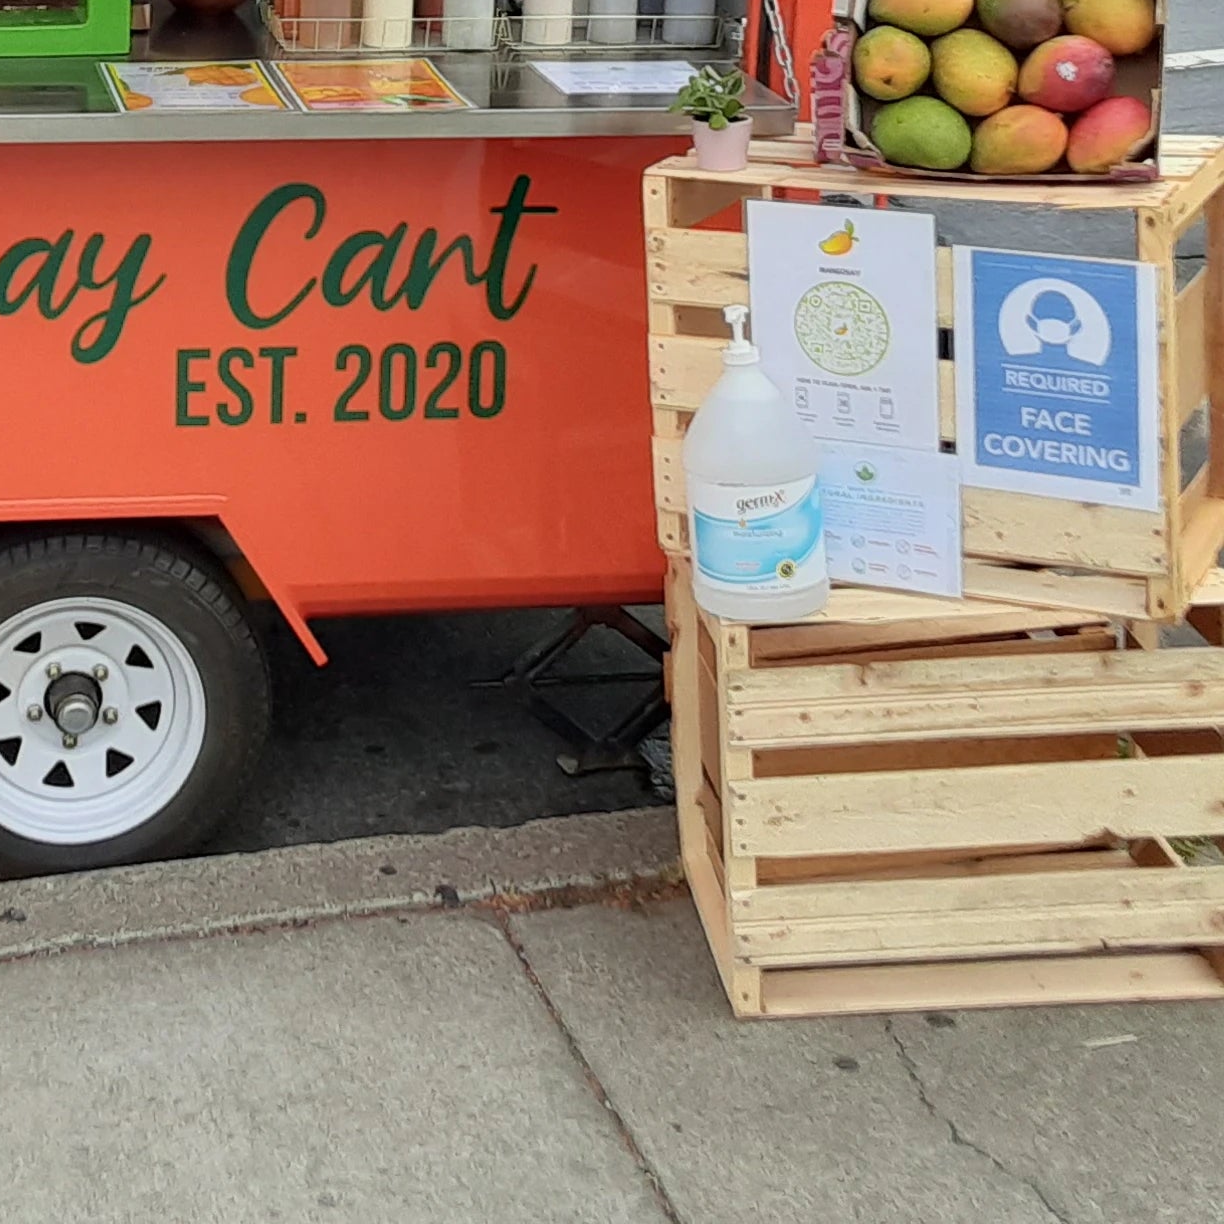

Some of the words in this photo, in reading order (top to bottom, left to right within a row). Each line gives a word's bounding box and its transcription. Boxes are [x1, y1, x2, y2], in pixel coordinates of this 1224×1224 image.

[225, 174, 559, 330] Cart
[175, 346, 308, 427] EST.
[333, 340, 507, 423] 2020
[1005, 369, 1111, 397] REQUIRED
[1020, 406, 1092, 436] FACE
[983, 432, 1131, 472] COVERING
